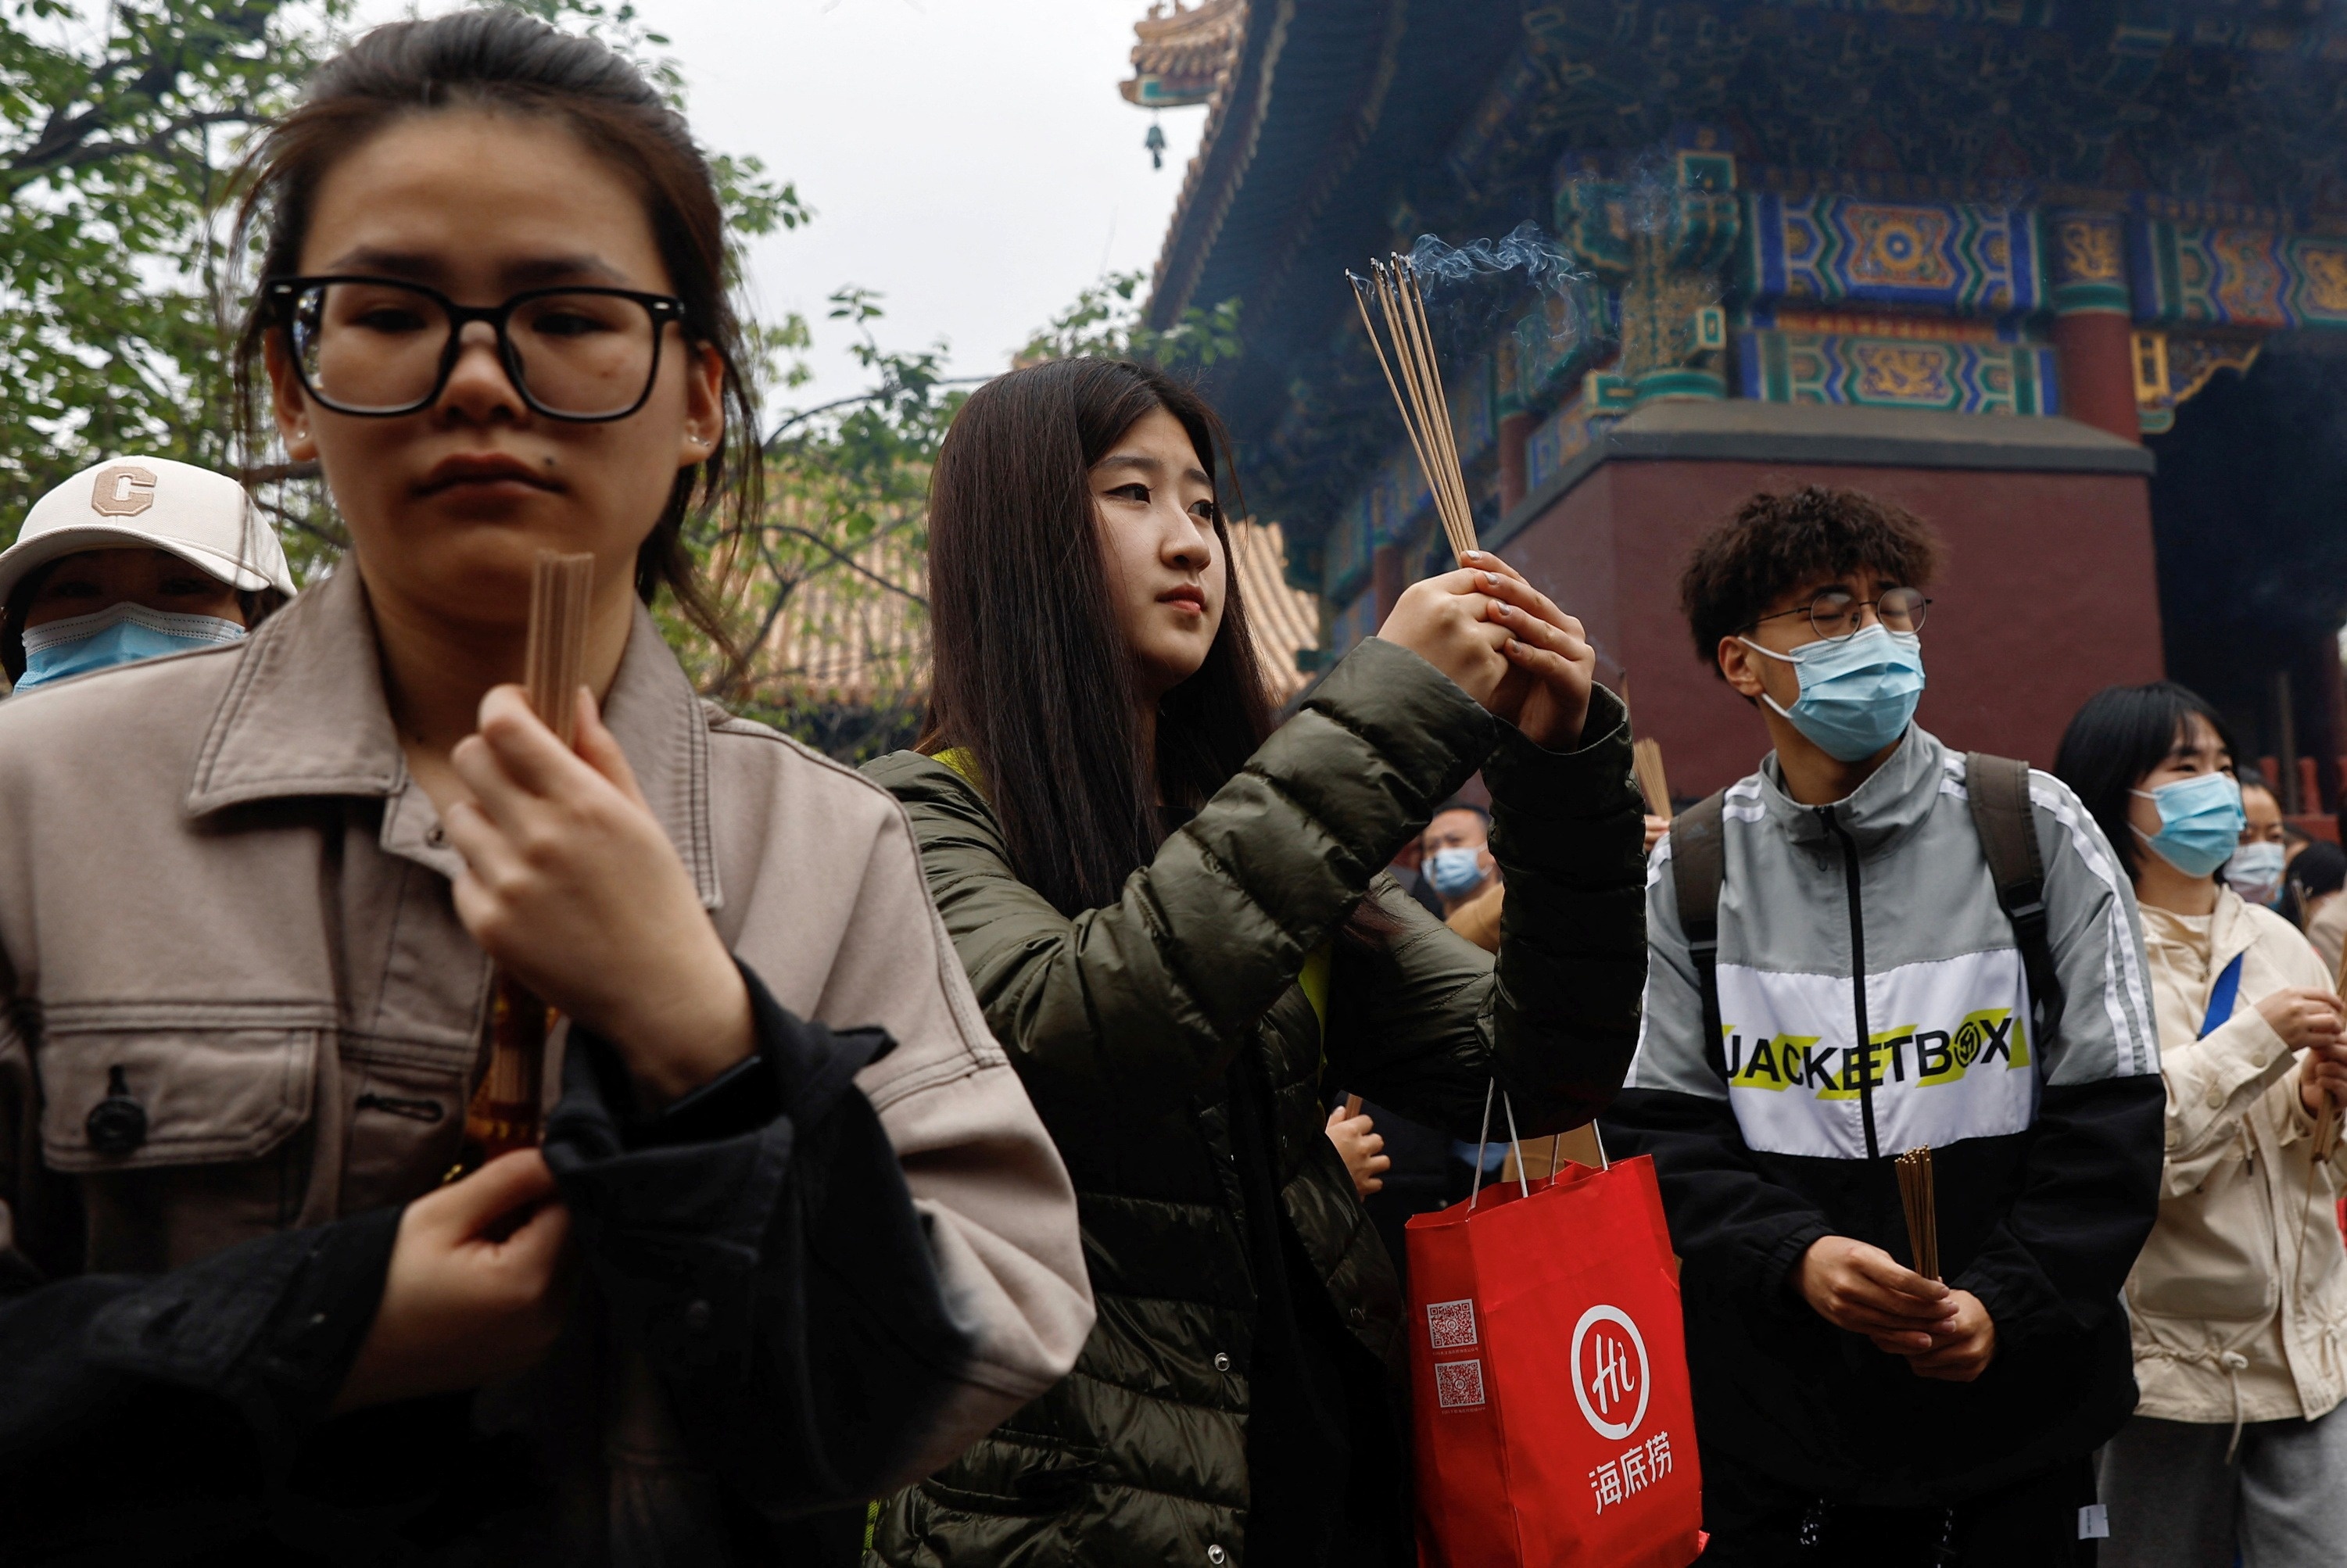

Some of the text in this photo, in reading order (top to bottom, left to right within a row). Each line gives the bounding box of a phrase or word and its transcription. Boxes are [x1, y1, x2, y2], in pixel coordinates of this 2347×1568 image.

[91, 466, 157, 517] C
[1726, 1018, 2012, 1091] JACKETBOX
[1593, 1334, 1635, 1414] Hi
[1589, 1431, 1673, 1516] 海底捞
